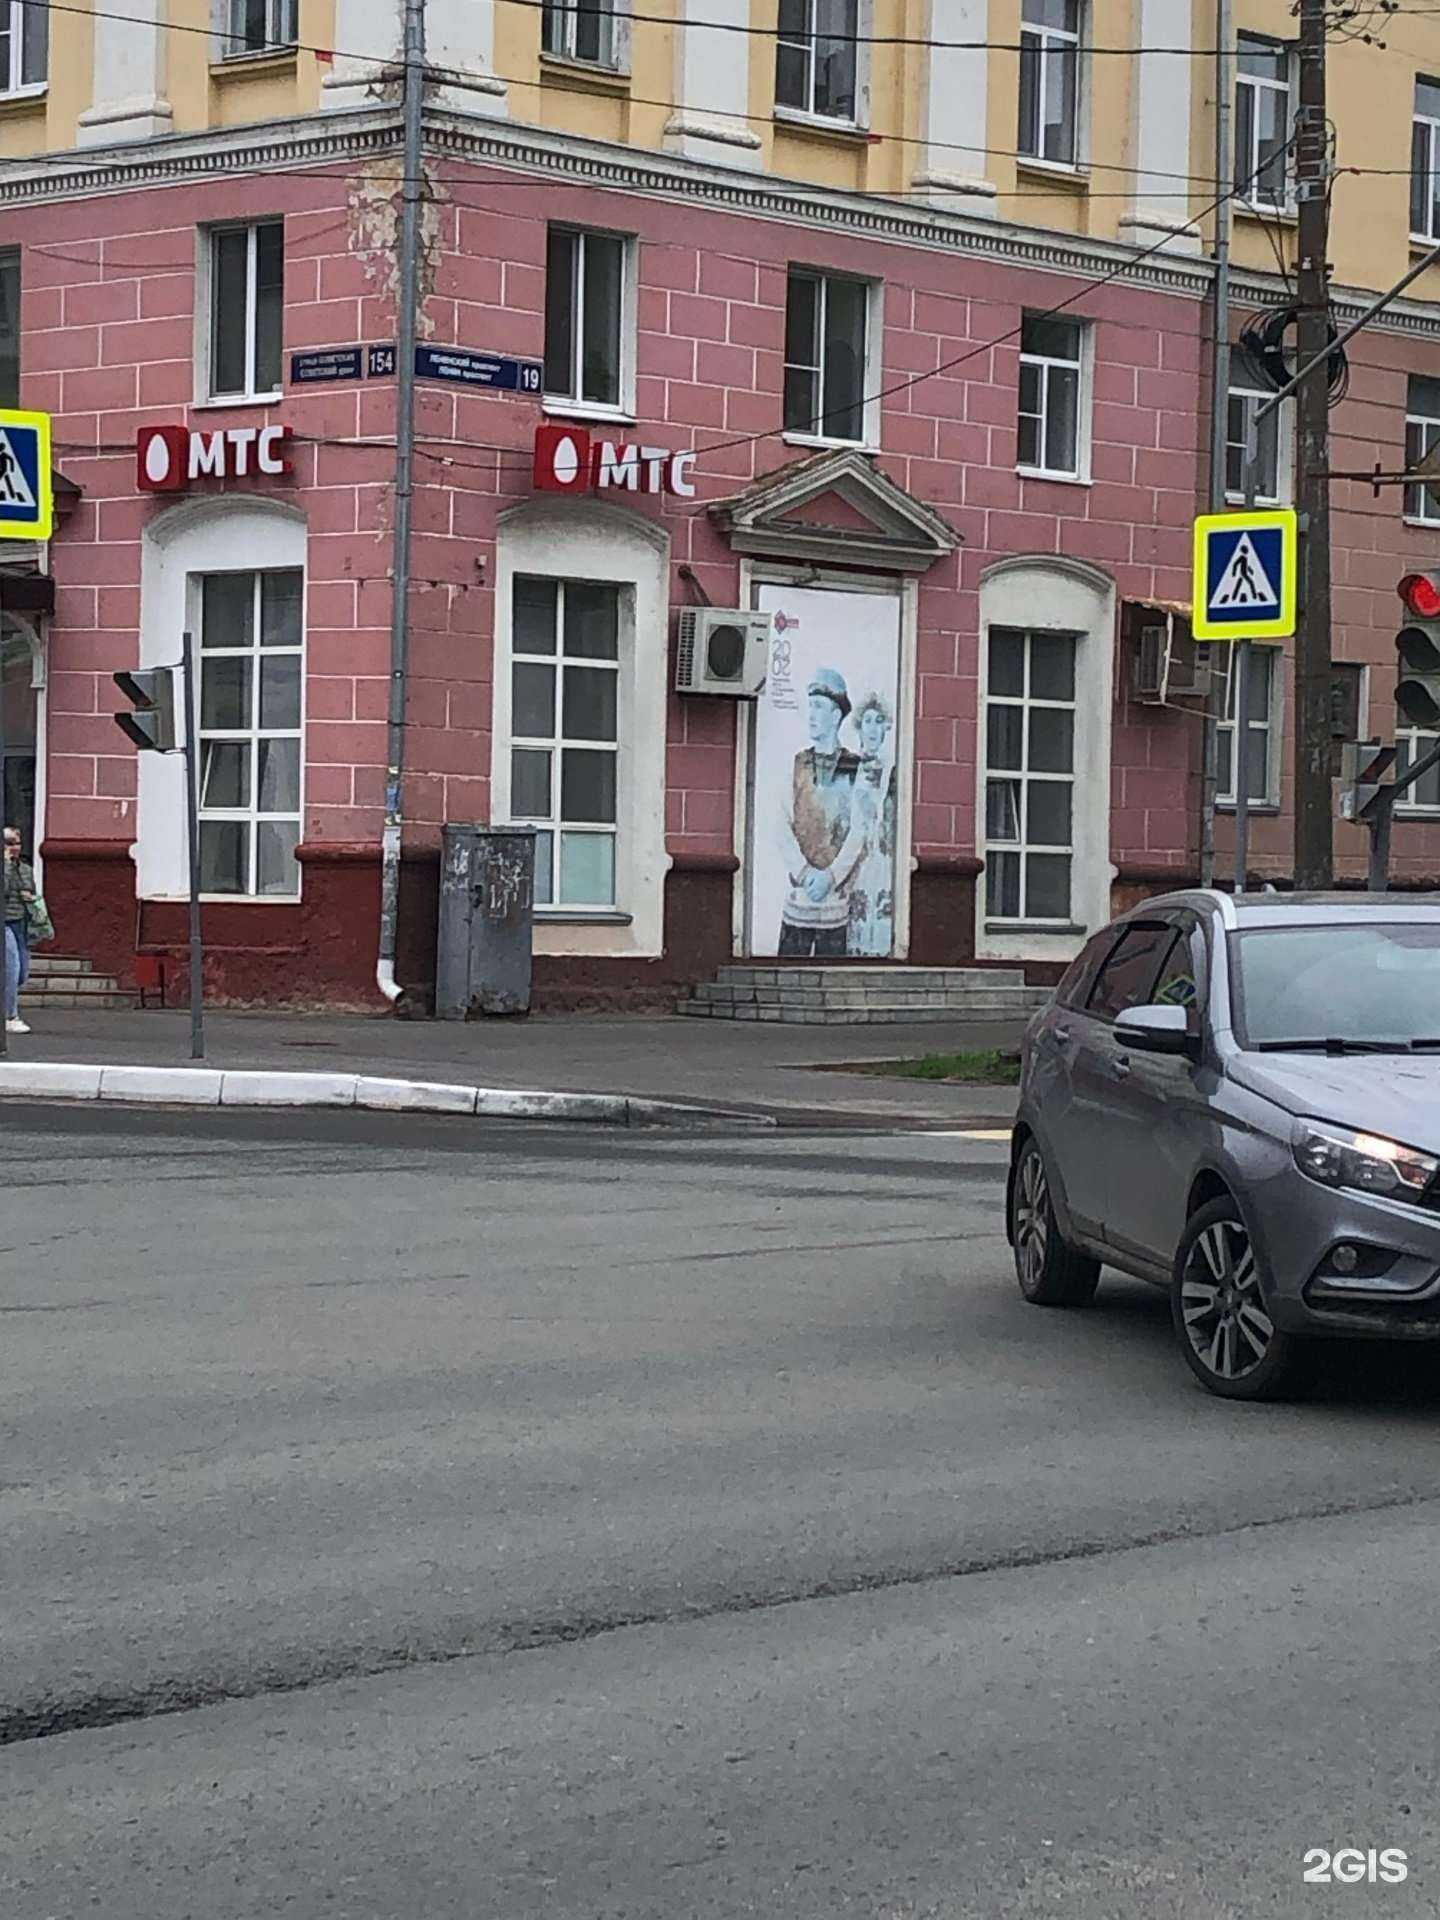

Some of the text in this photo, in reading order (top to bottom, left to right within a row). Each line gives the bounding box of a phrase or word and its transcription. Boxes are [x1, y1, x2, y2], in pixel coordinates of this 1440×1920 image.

[370, 352, 393, 372] 154
[523, 369, 539, 389] 19
[188, 425, 285, 480] МТС
[598, 441, 697, 497] МТС
